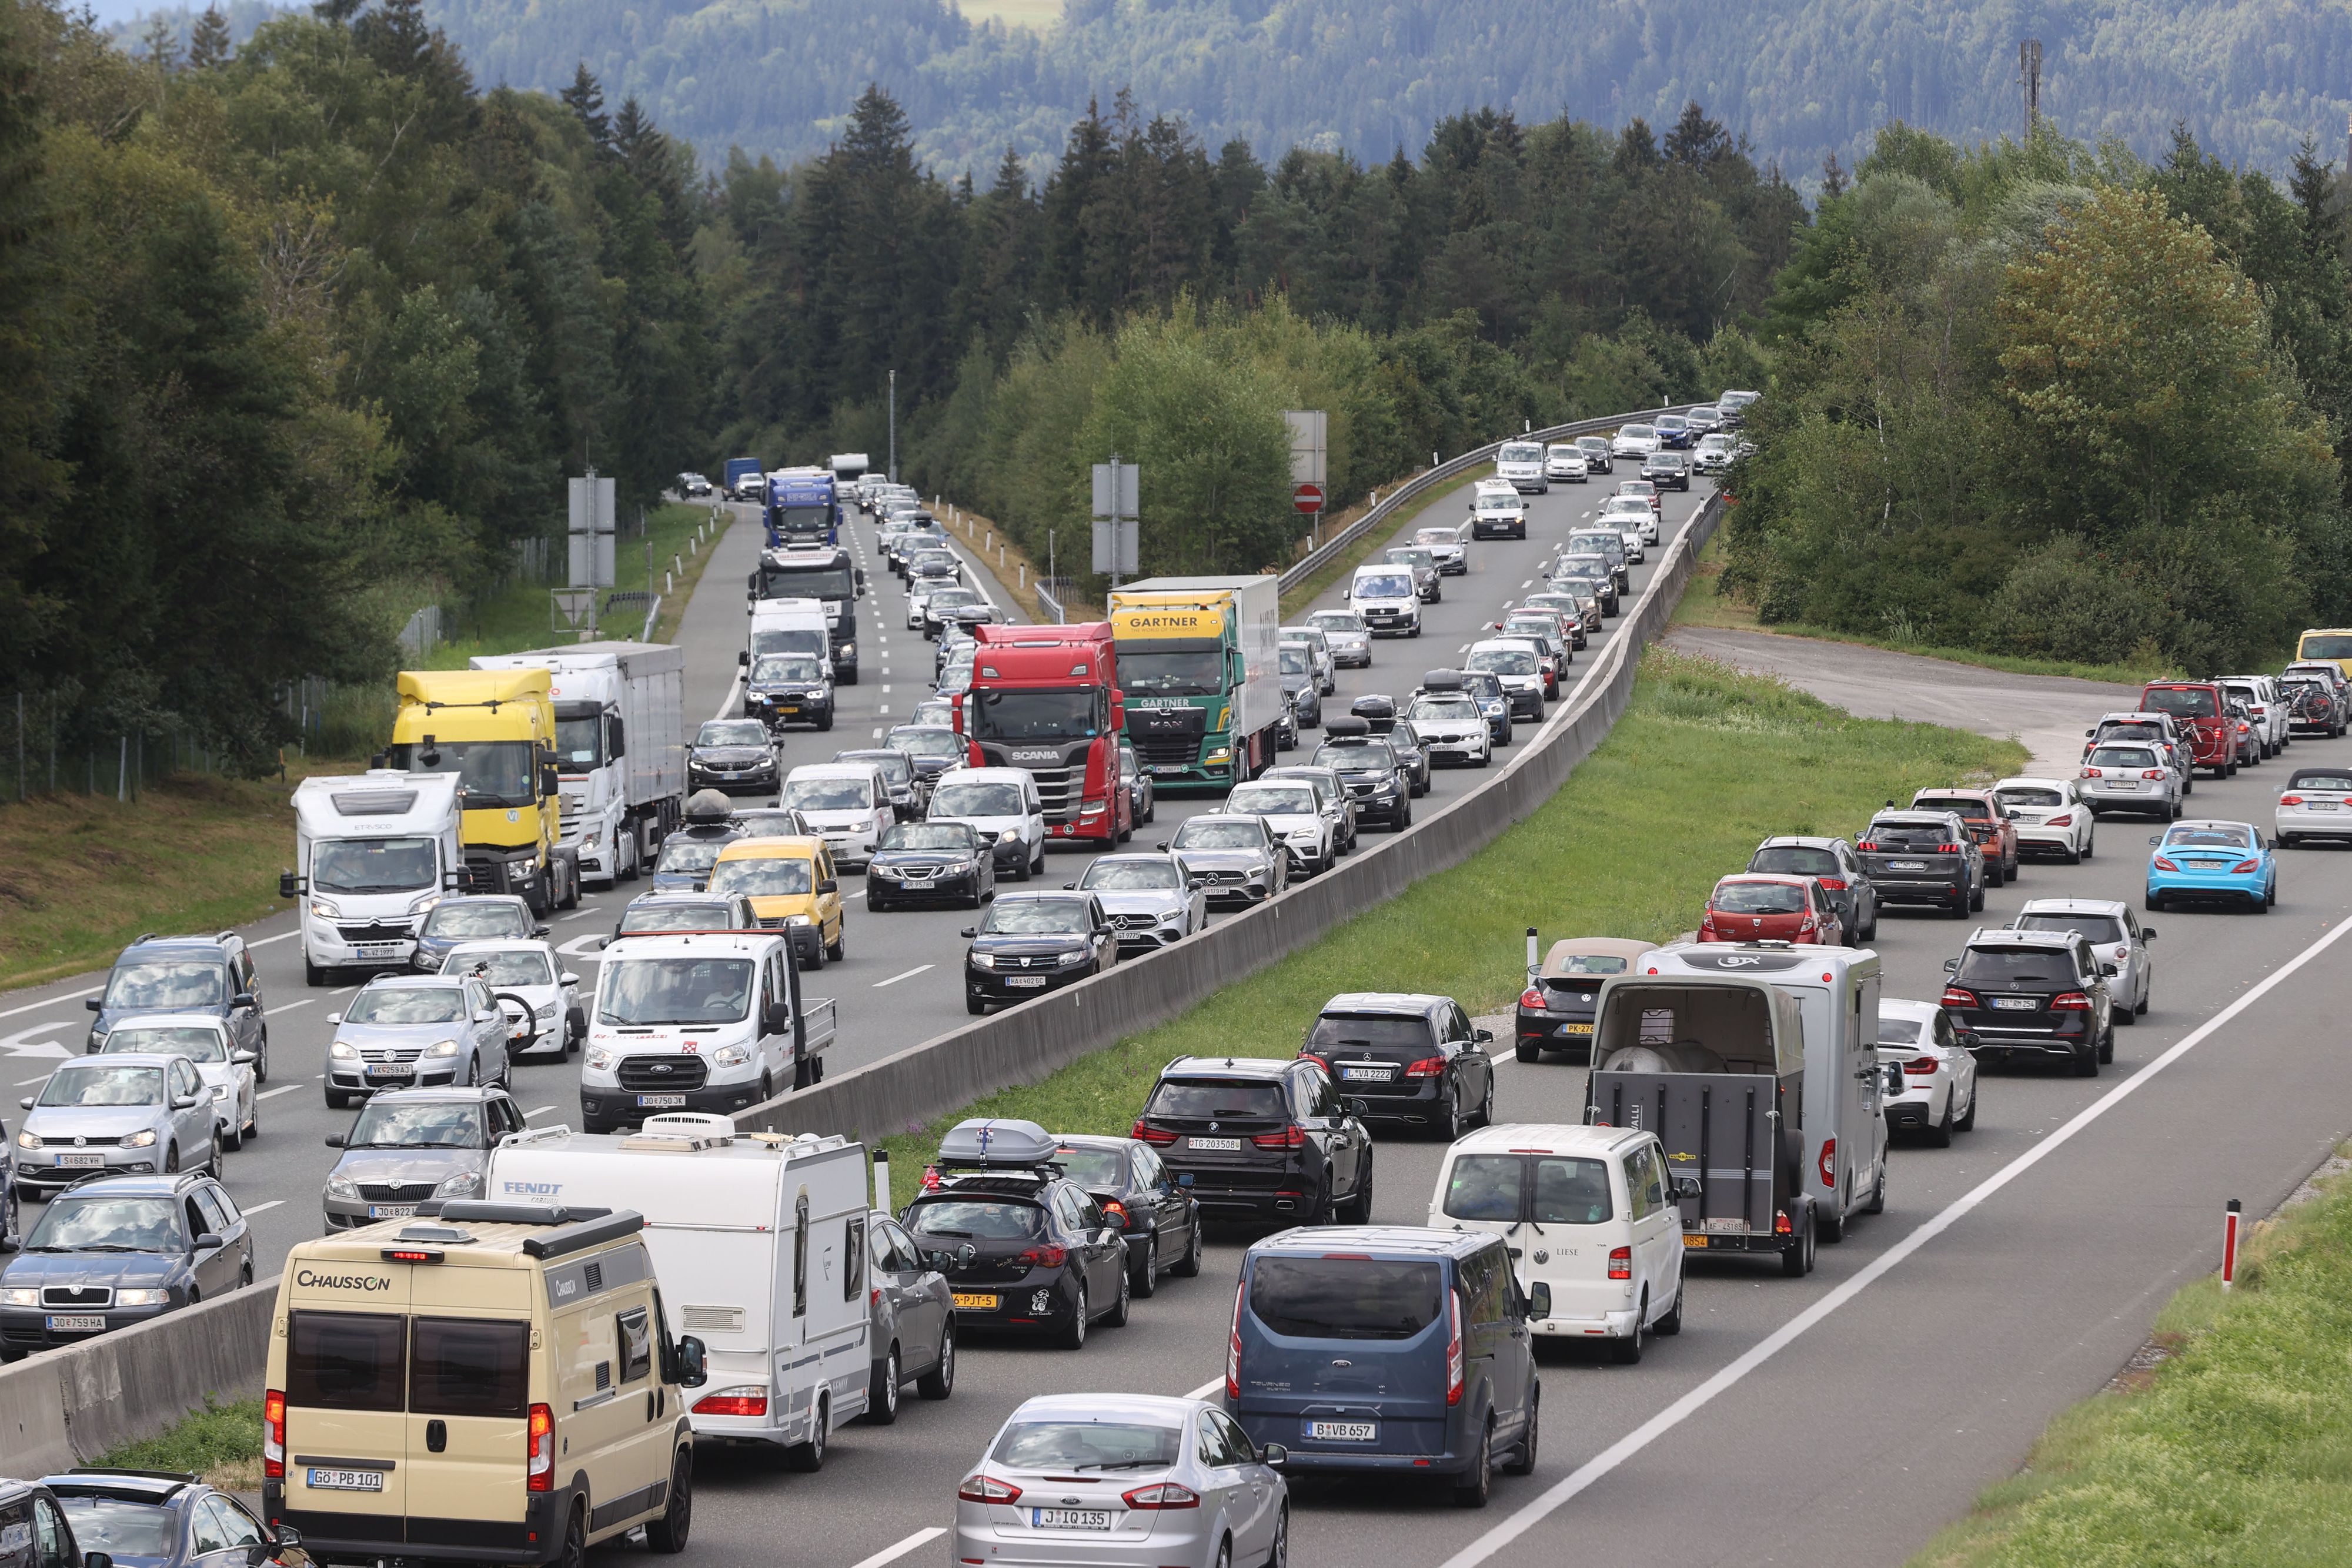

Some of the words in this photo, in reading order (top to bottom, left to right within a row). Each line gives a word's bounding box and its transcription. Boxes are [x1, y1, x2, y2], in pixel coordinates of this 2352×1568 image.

[1130, 617, 1198, 627] GARTNER
[1141, 698, 1190, 708] GARTNER
[1011, 751, 1060, 760] SCANIA
[510, 812, 517, 820] VI
[1727, 955, 1759, 964] STX
[1371, 1070, 1390, 1078] 2222
[64, 1156, 69, 1165] S
[74, 1156, 87, 1165] 682
[504, 1181, 563, 1195] FENDT
[379, 1208, 388, 1216] JO
[395, 1208, 409, 1216] 822
[297, 1269, 391, 1291] CHAUSSON
[556, 1279, 576, 1297] CHAUSSON
[54, 1318, 64, 1327] JO
[72, 1318, 87, 1327] 759
[91, 1318, 102, 1327] HA
[1317, 1424, 1324, 1433] B
[1332, 1425, 1347, 1435] VB
[1349, 1425, 1370, 1435] 657
[315, 1471, 330, 1483] GÖ
[339, 1472, 355, 1485] PB
[358, 1473, 380, 1486] 101
[1045, 1512, 1054, 1523] J
[1063, 1512, 1078, 1524] IQ
[1081, 1513, 1105, 1525] 135
